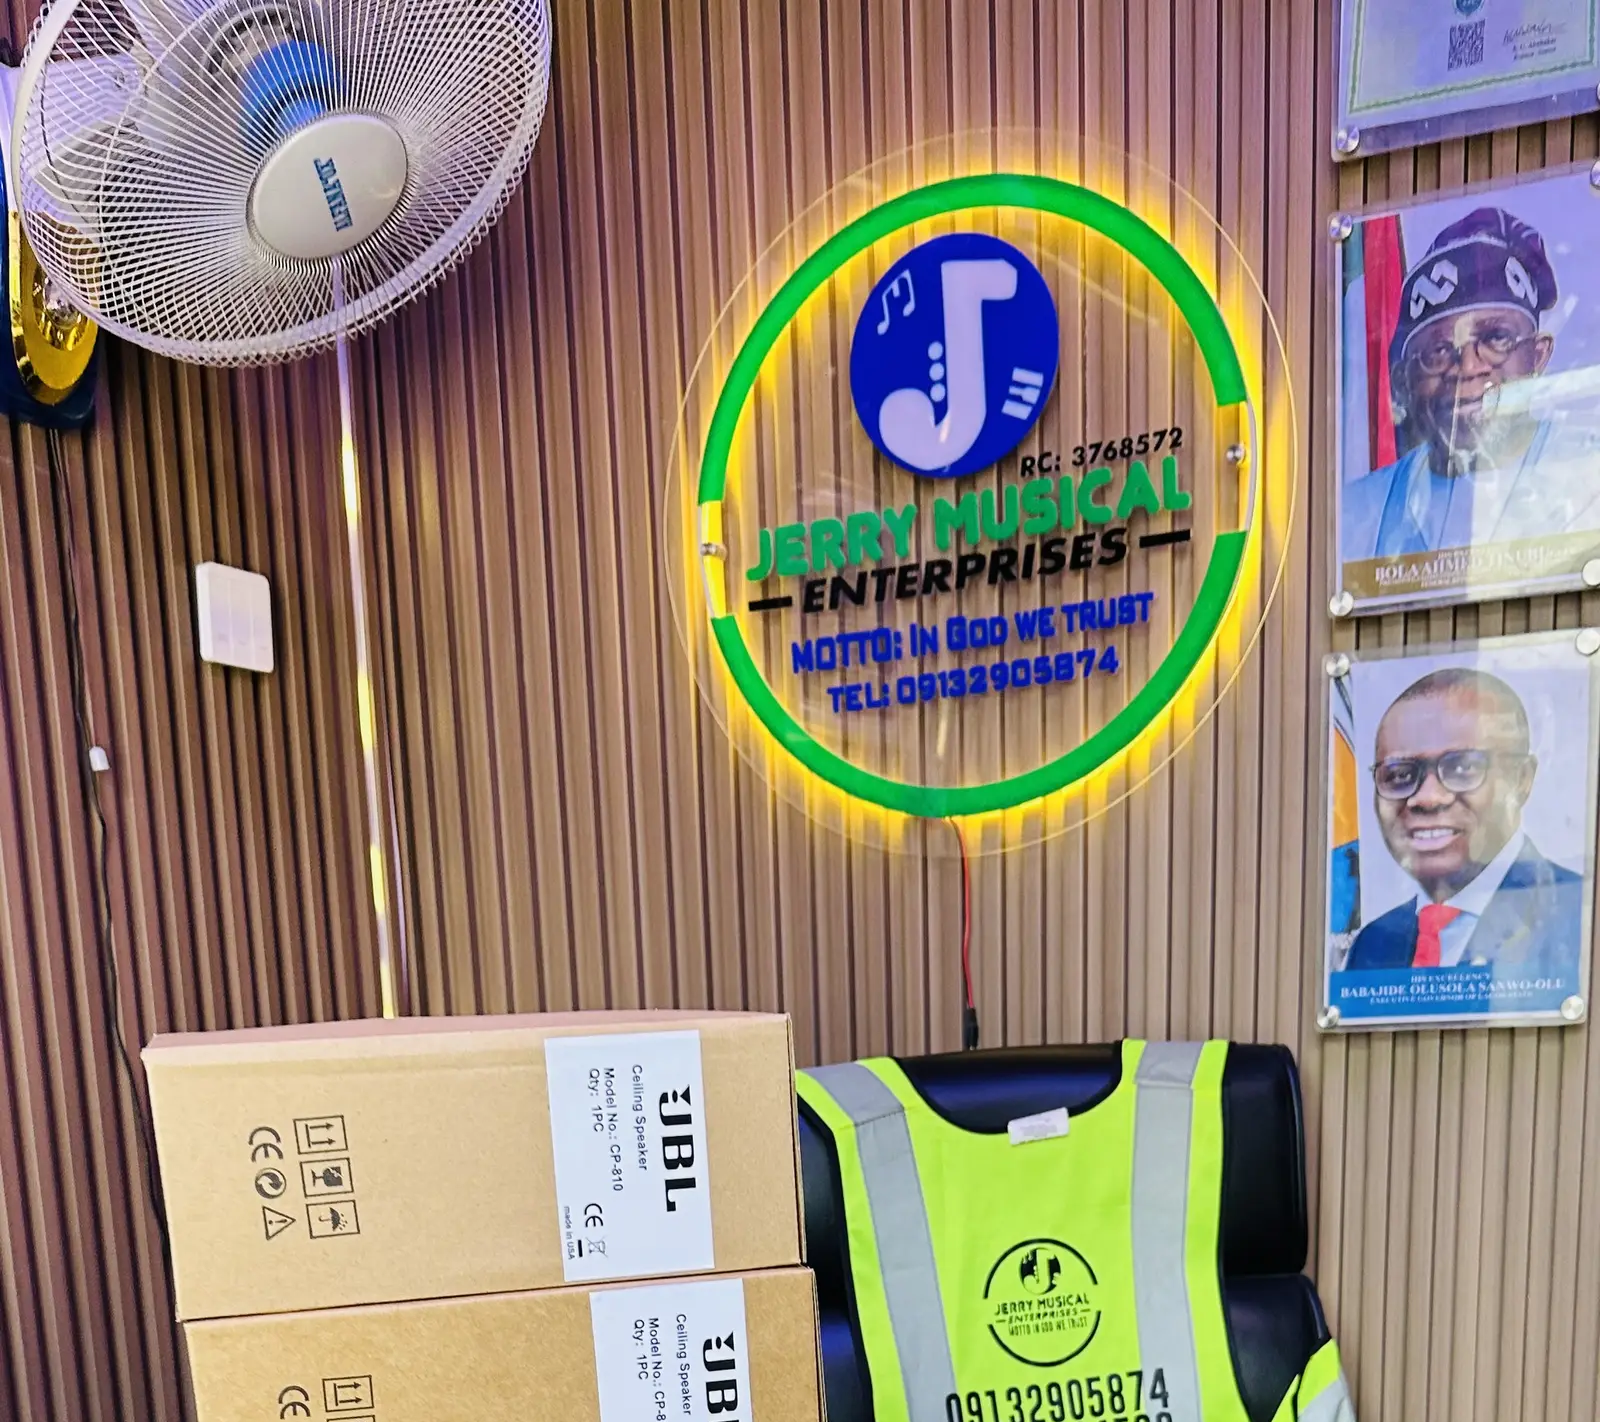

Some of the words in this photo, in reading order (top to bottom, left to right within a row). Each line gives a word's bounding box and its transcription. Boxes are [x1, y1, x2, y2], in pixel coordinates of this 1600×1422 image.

[1020, 452, 1061, 477] RC:
[1072, 427, 1183, 467] 3768572
[746, 504, 917, 582] JERRY
[933, 455, 1192, 551] MUSICAL
[803, 527, 1127, 613] ENTERPRISES
[791, 627, 903, 674] MOTTO:
[1014, 606, 1056, 641] WE
[1060, 592, 1154, 633] TRUST
[827, 683, 890, 714] TEL:
[896, 645, 1120, 705] 09132905874
[1340, 985, 1406, 998] BABAJIDE
[1409, 981, 1476, 995] OLUSOLA
[1478, 978, 1565, 993] SANWO-OLU
[588, 1068, 600, 1097] Qty:
[604, 1067, 618, 1109] Model
[632, 1064, 644, 1112] Ceiling
[592, 1105, 604, 1132] 1PC
[607, 1112, 619, 1140] No.:
[633, 1116, 649, 1170] Speaker
[659, 1091, 696, 1212] JBL
[609, 1144, 624, 1191] CP-810
[563, 1206, 573, 1231] made
[567, 1241, 575, 1260] USA
[994, 1300, 1033, 1316] JERRY
[1037, 1293, 1090, 1310] MUSICAL
[1008, 1307, 1078, 1324] ENTERPRISES
[632, 1319, 645, 1347] Qty:
[649, 1318, 661, 1357] Model
[676, 1313, 688, 1359] Ceiling
[1008, 1323, 1031, 1336] MOTTO
[1041, 1321, 1054, 1333] GOD
[637, 1355, 649, 1380] 1PC
[651, 1360, 663, 1388] No.:
[677, 1363, 692, 1415] Speaker
